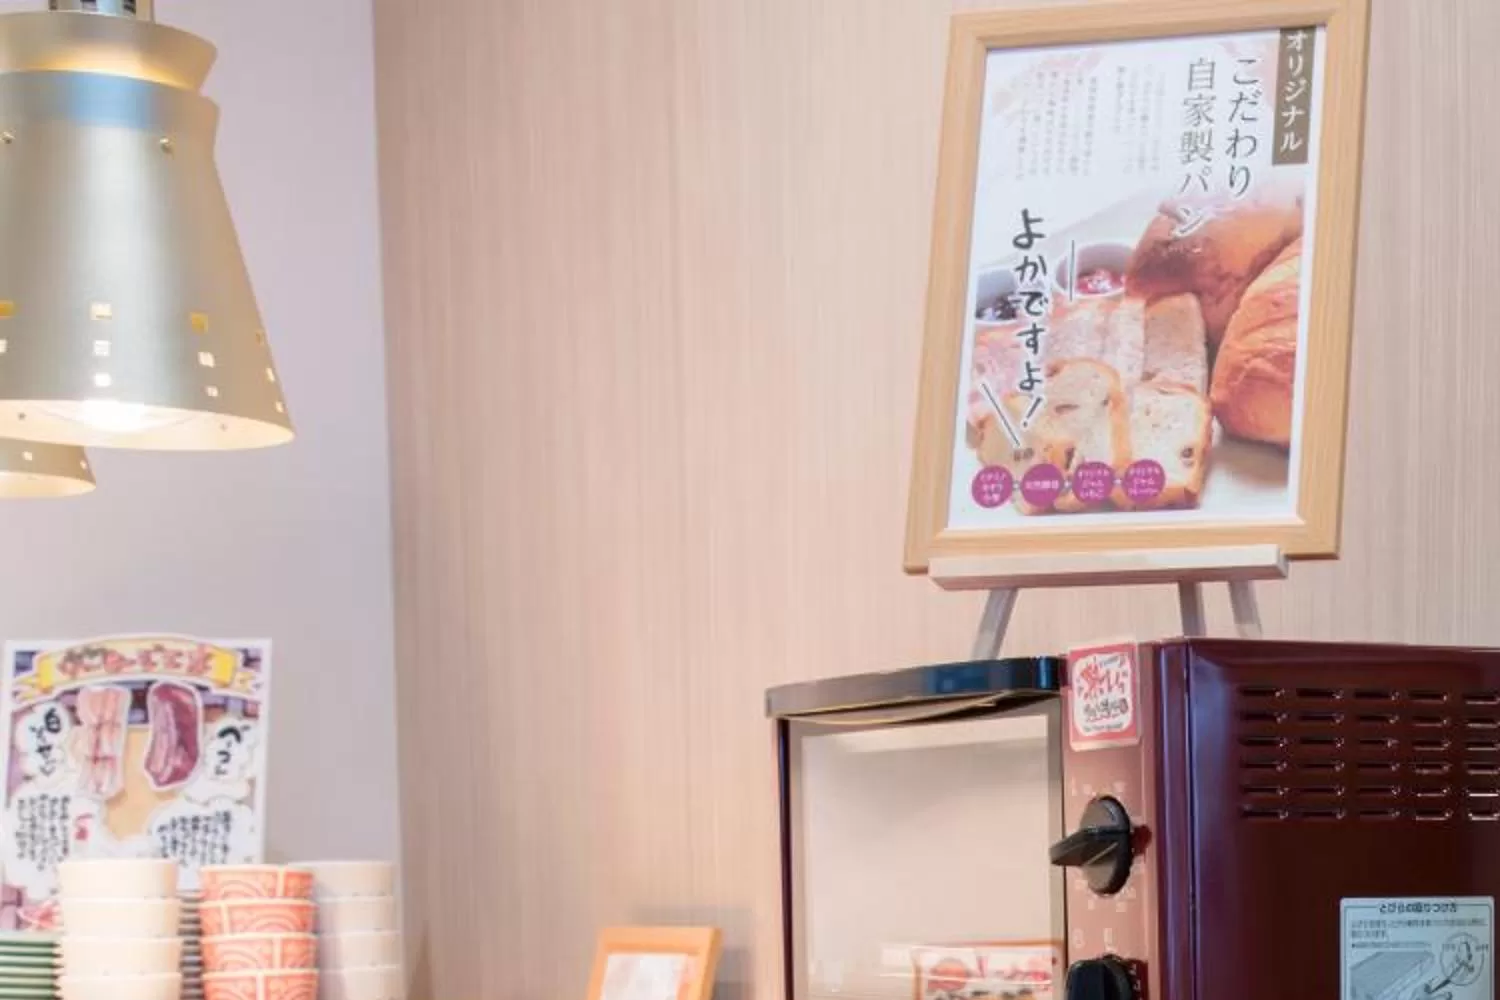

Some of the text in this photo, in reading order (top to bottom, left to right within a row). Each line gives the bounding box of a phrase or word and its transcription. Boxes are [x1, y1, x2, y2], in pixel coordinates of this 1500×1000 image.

[1172, 57, 1217, 238] 自家製パン
[1225, 57, 1263, 198] こだわり
[1280, 32, 1309, 153] オリジナル
